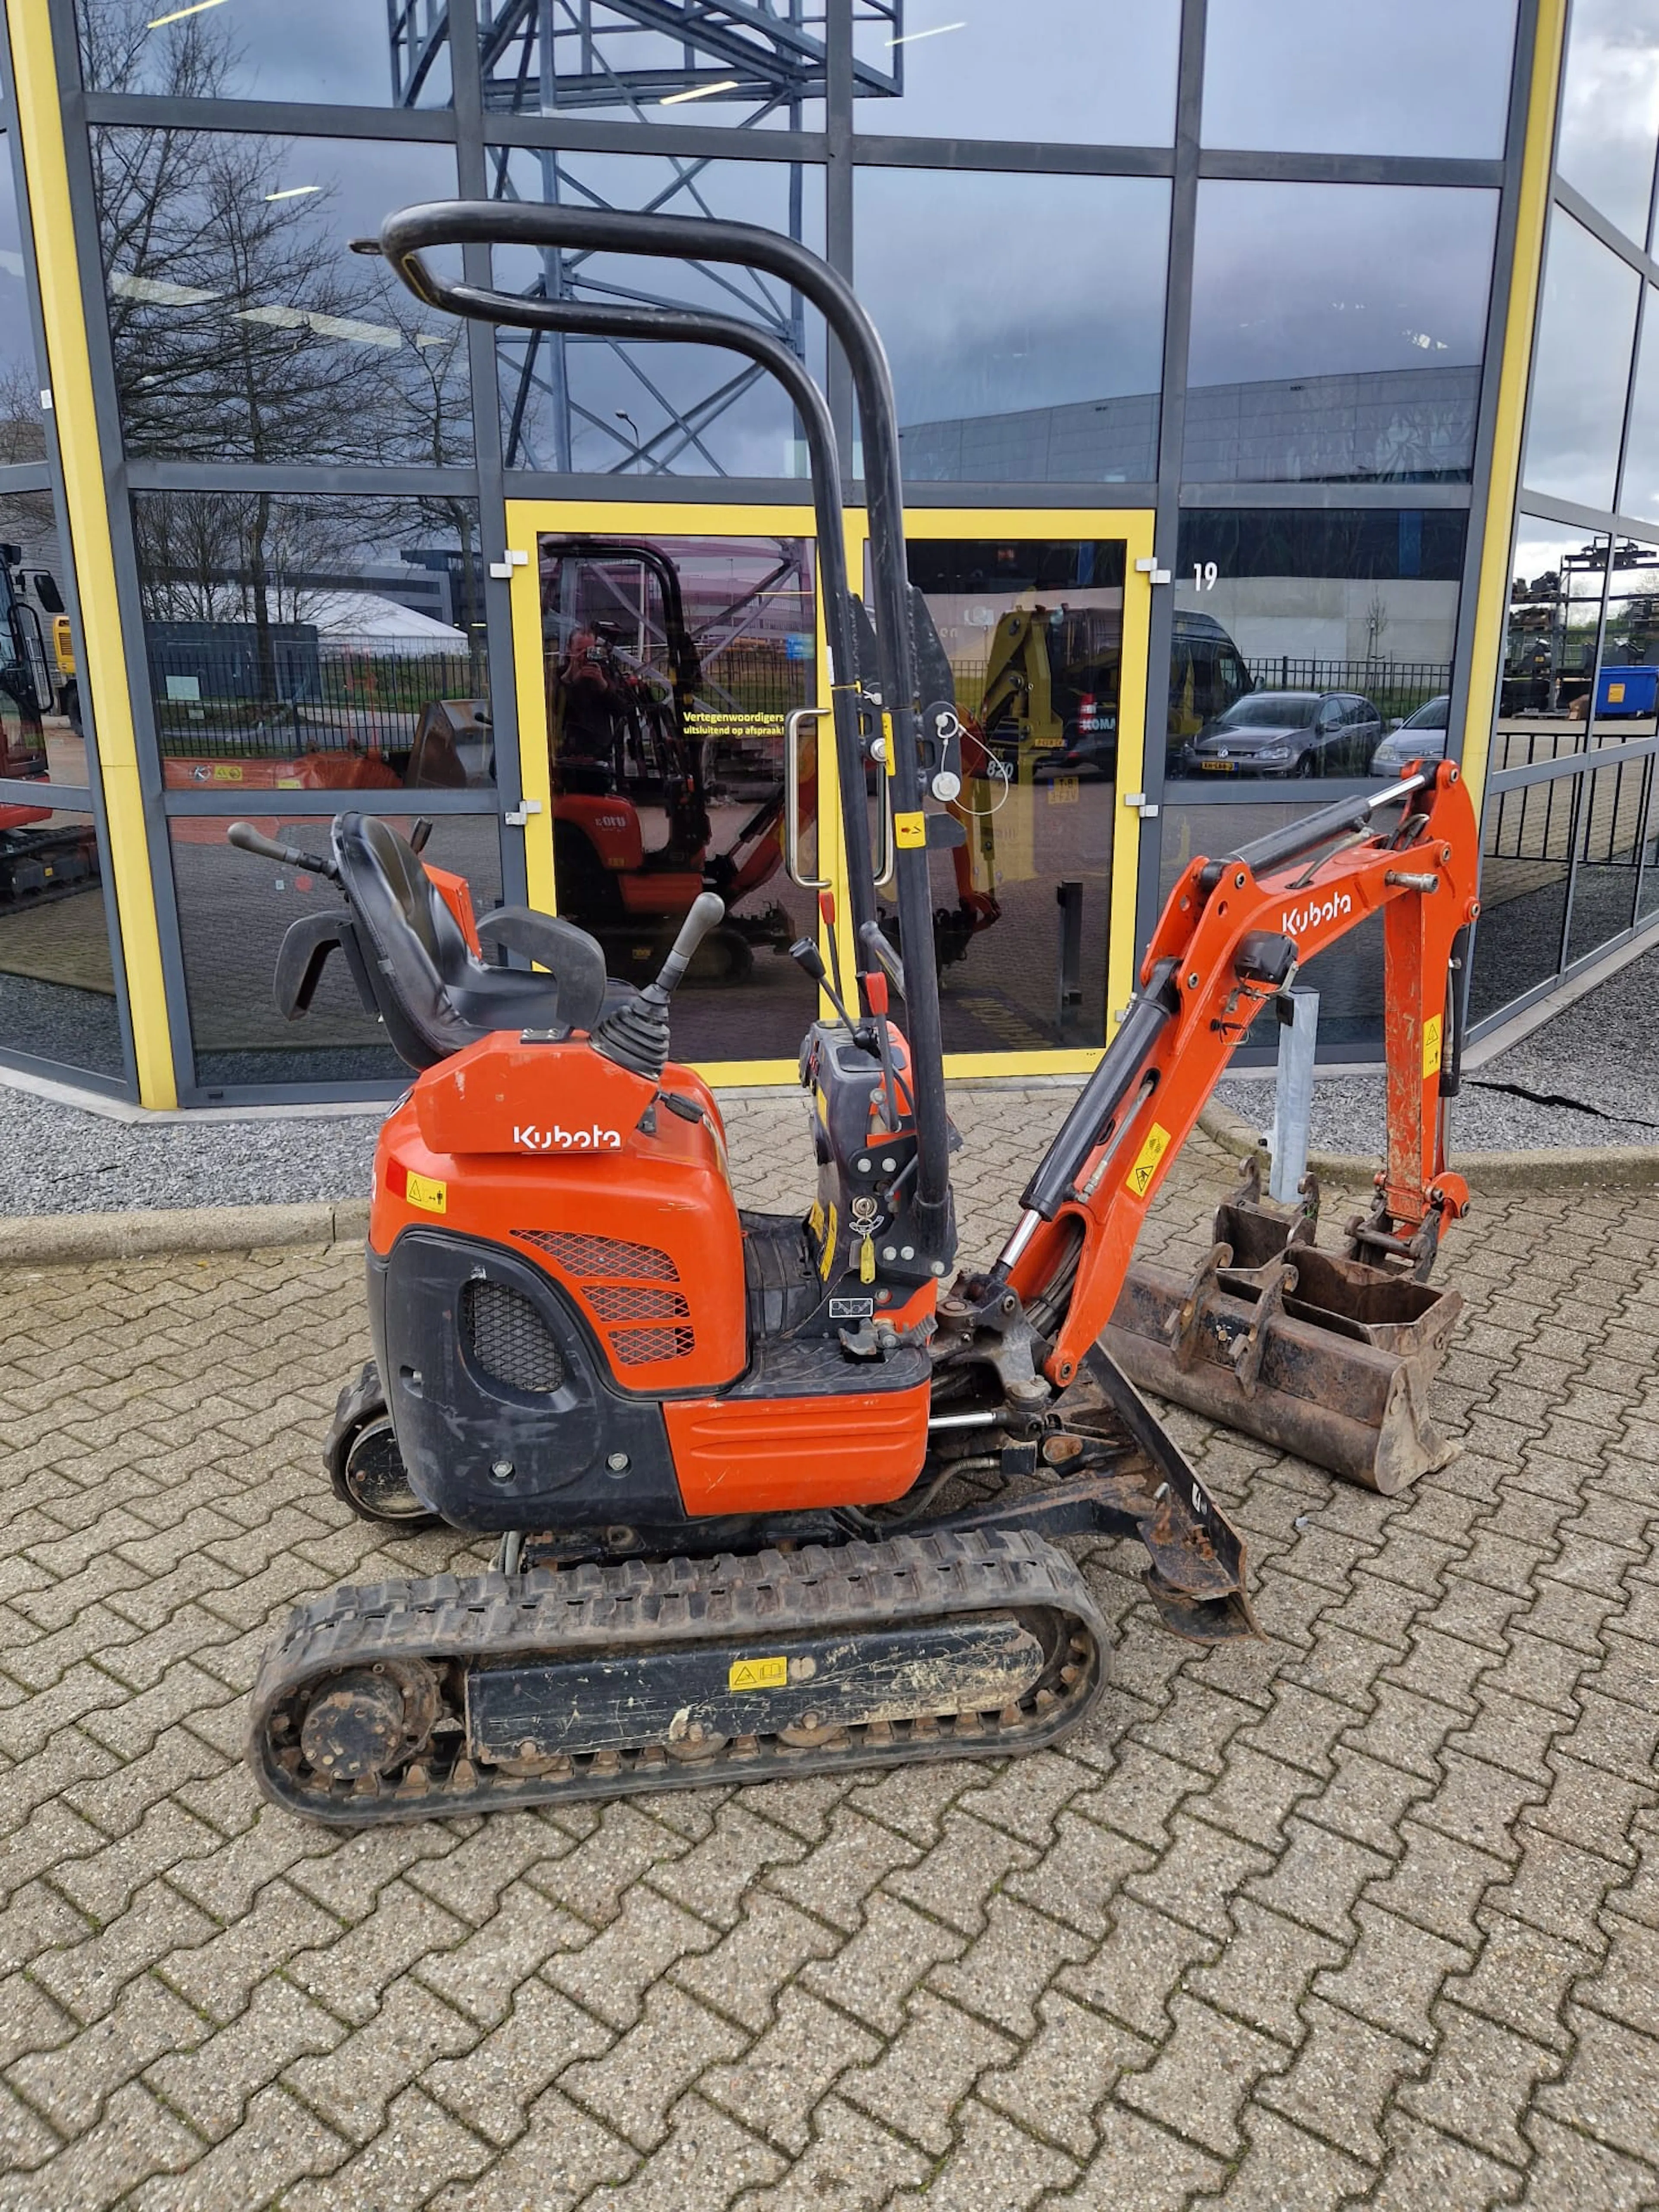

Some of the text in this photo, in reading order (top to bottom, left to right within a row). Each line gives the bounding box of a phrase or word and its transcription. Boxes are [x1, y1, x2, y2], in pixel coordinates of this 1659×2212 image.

[1194, 561, 1217, 591] 19
[683, 712, 785, 724] Vertegenwoordigers
[683, 725, 785, 736] uitsluitend op afspraak!
[987, 760, 1014, 779] 820
[1282, 891, 1351, 936] Kubota
[514, 1124, 621, 1149] Kubota
